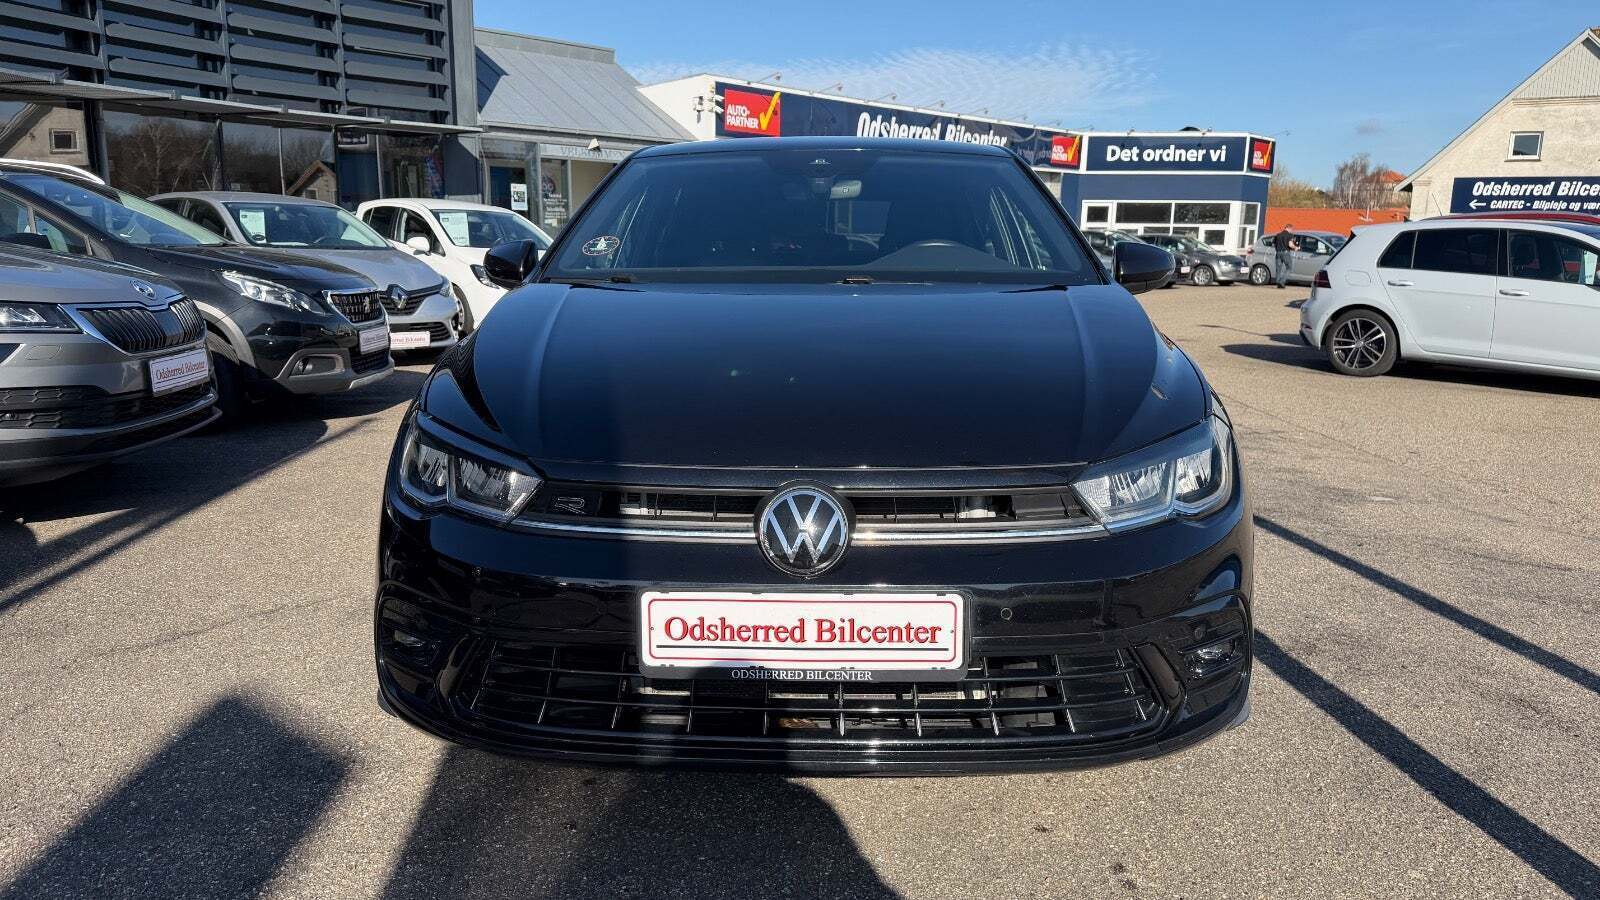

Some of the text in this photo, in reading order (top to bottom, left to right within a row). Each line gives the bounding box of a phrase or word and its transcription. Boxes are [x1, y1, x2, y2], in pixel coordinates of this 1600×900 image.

[726, 103, 750, 117] AUTO-
[726, 115, 759, 129] PARTNER
[1106, 145, 1227, 163] Det ordner vi
[1472, 181, 1600, 196] Odsherred Bilce
[1490, 200, 1525, 209] CARTEC
[1532, 200, 1568, 211] Bilpleje
[1569, 202, 1581, 211] og
[1583, 202, 1600, 210] vær
[664, 615, 942, 645] Odsherred Bilcenter
[731, 669, 873, 682] ODSHERRED BILCENTER
